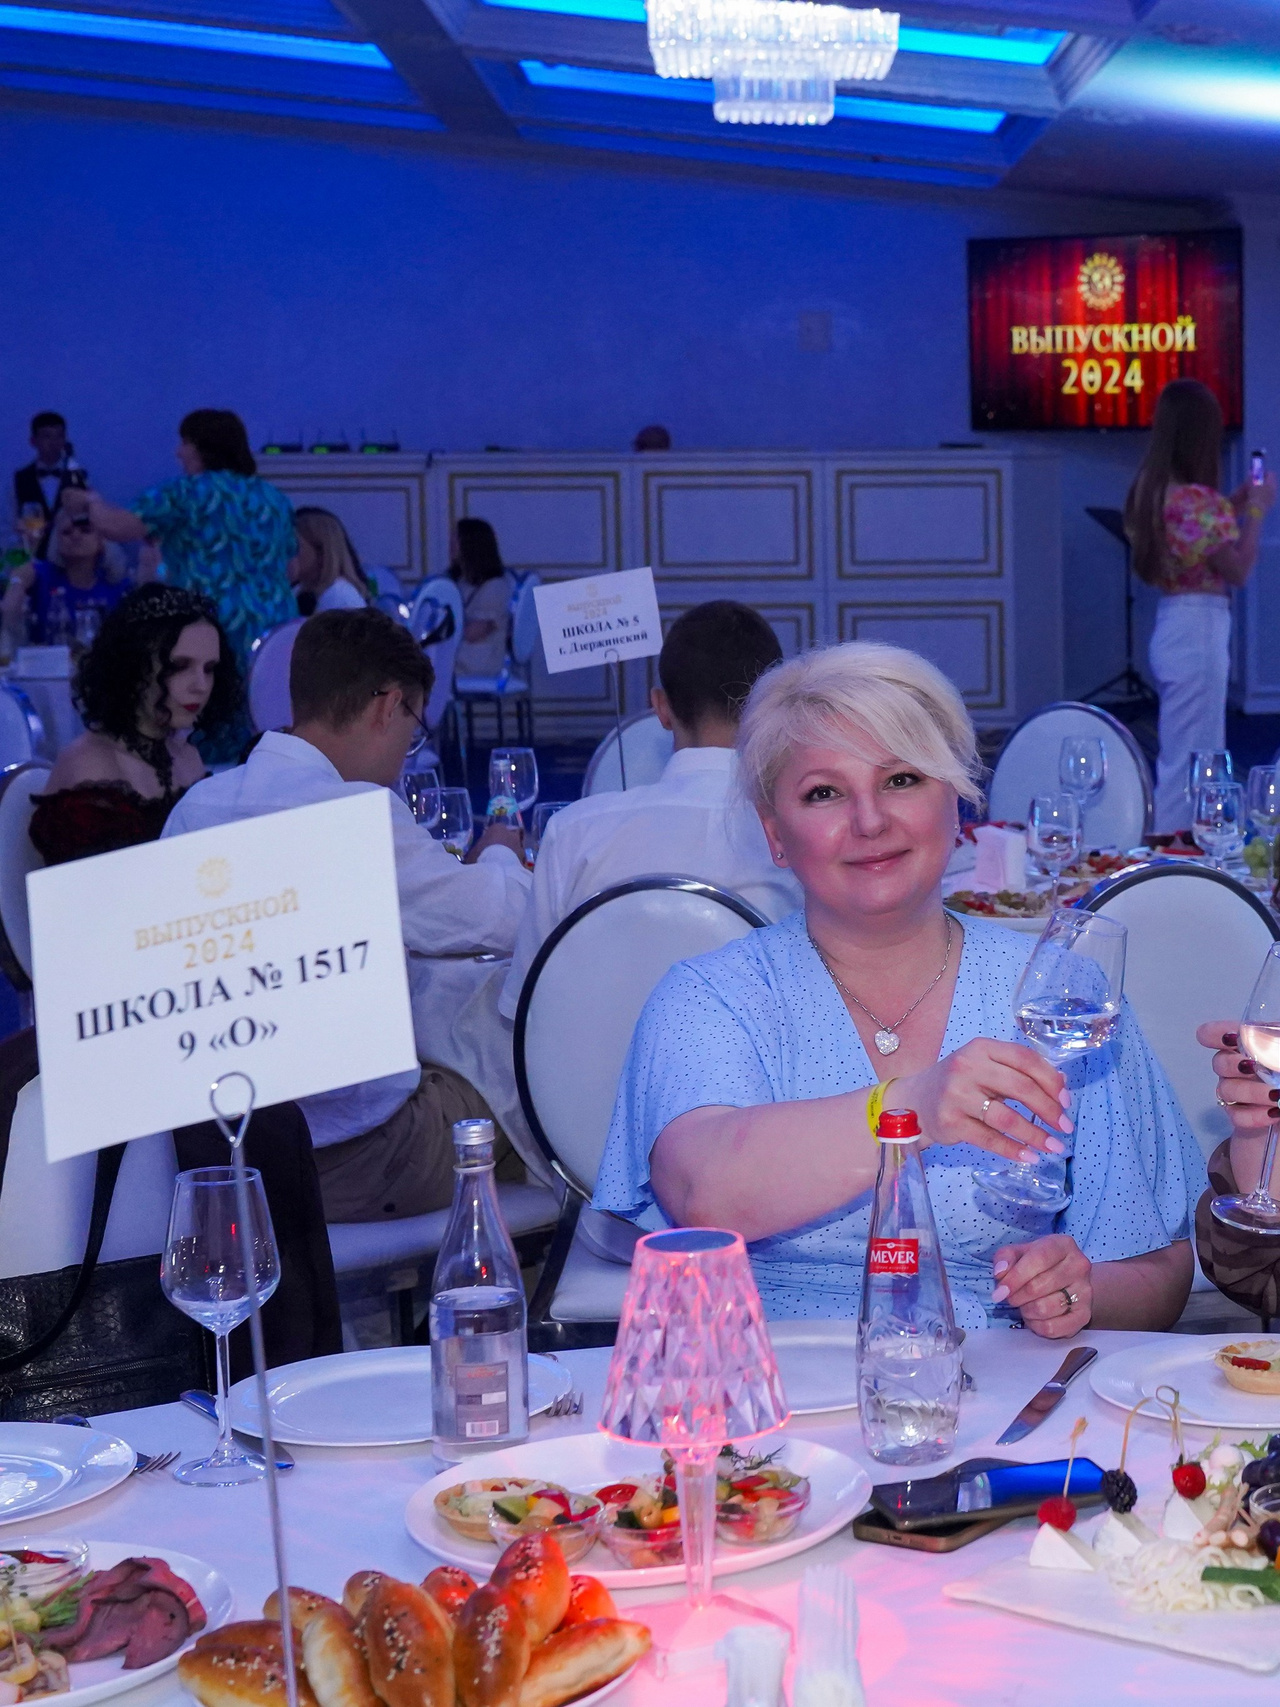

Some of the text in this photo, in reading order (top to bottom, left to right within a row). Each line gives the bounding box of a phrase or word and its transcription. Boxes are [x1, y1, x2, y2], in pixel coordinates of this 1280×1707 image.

[1010, 315, 1196, 354] ВЫПУСКНОЙ
[1061, 359, 1144, 394] 2024
[562, 615, 640, 638] ШКОЛА № 5
[569, 630, 648, 654] Дзержинский
[134, 888, 301, 951] ВЫПУСКНОЙ
[183, 929, 256, 969] 2024
[76, 940, 370, 1041] ШКОЛА № 1517
[178, 1031, 196, 1061] 9
[870, 1250, 916, 1264] MEVER
